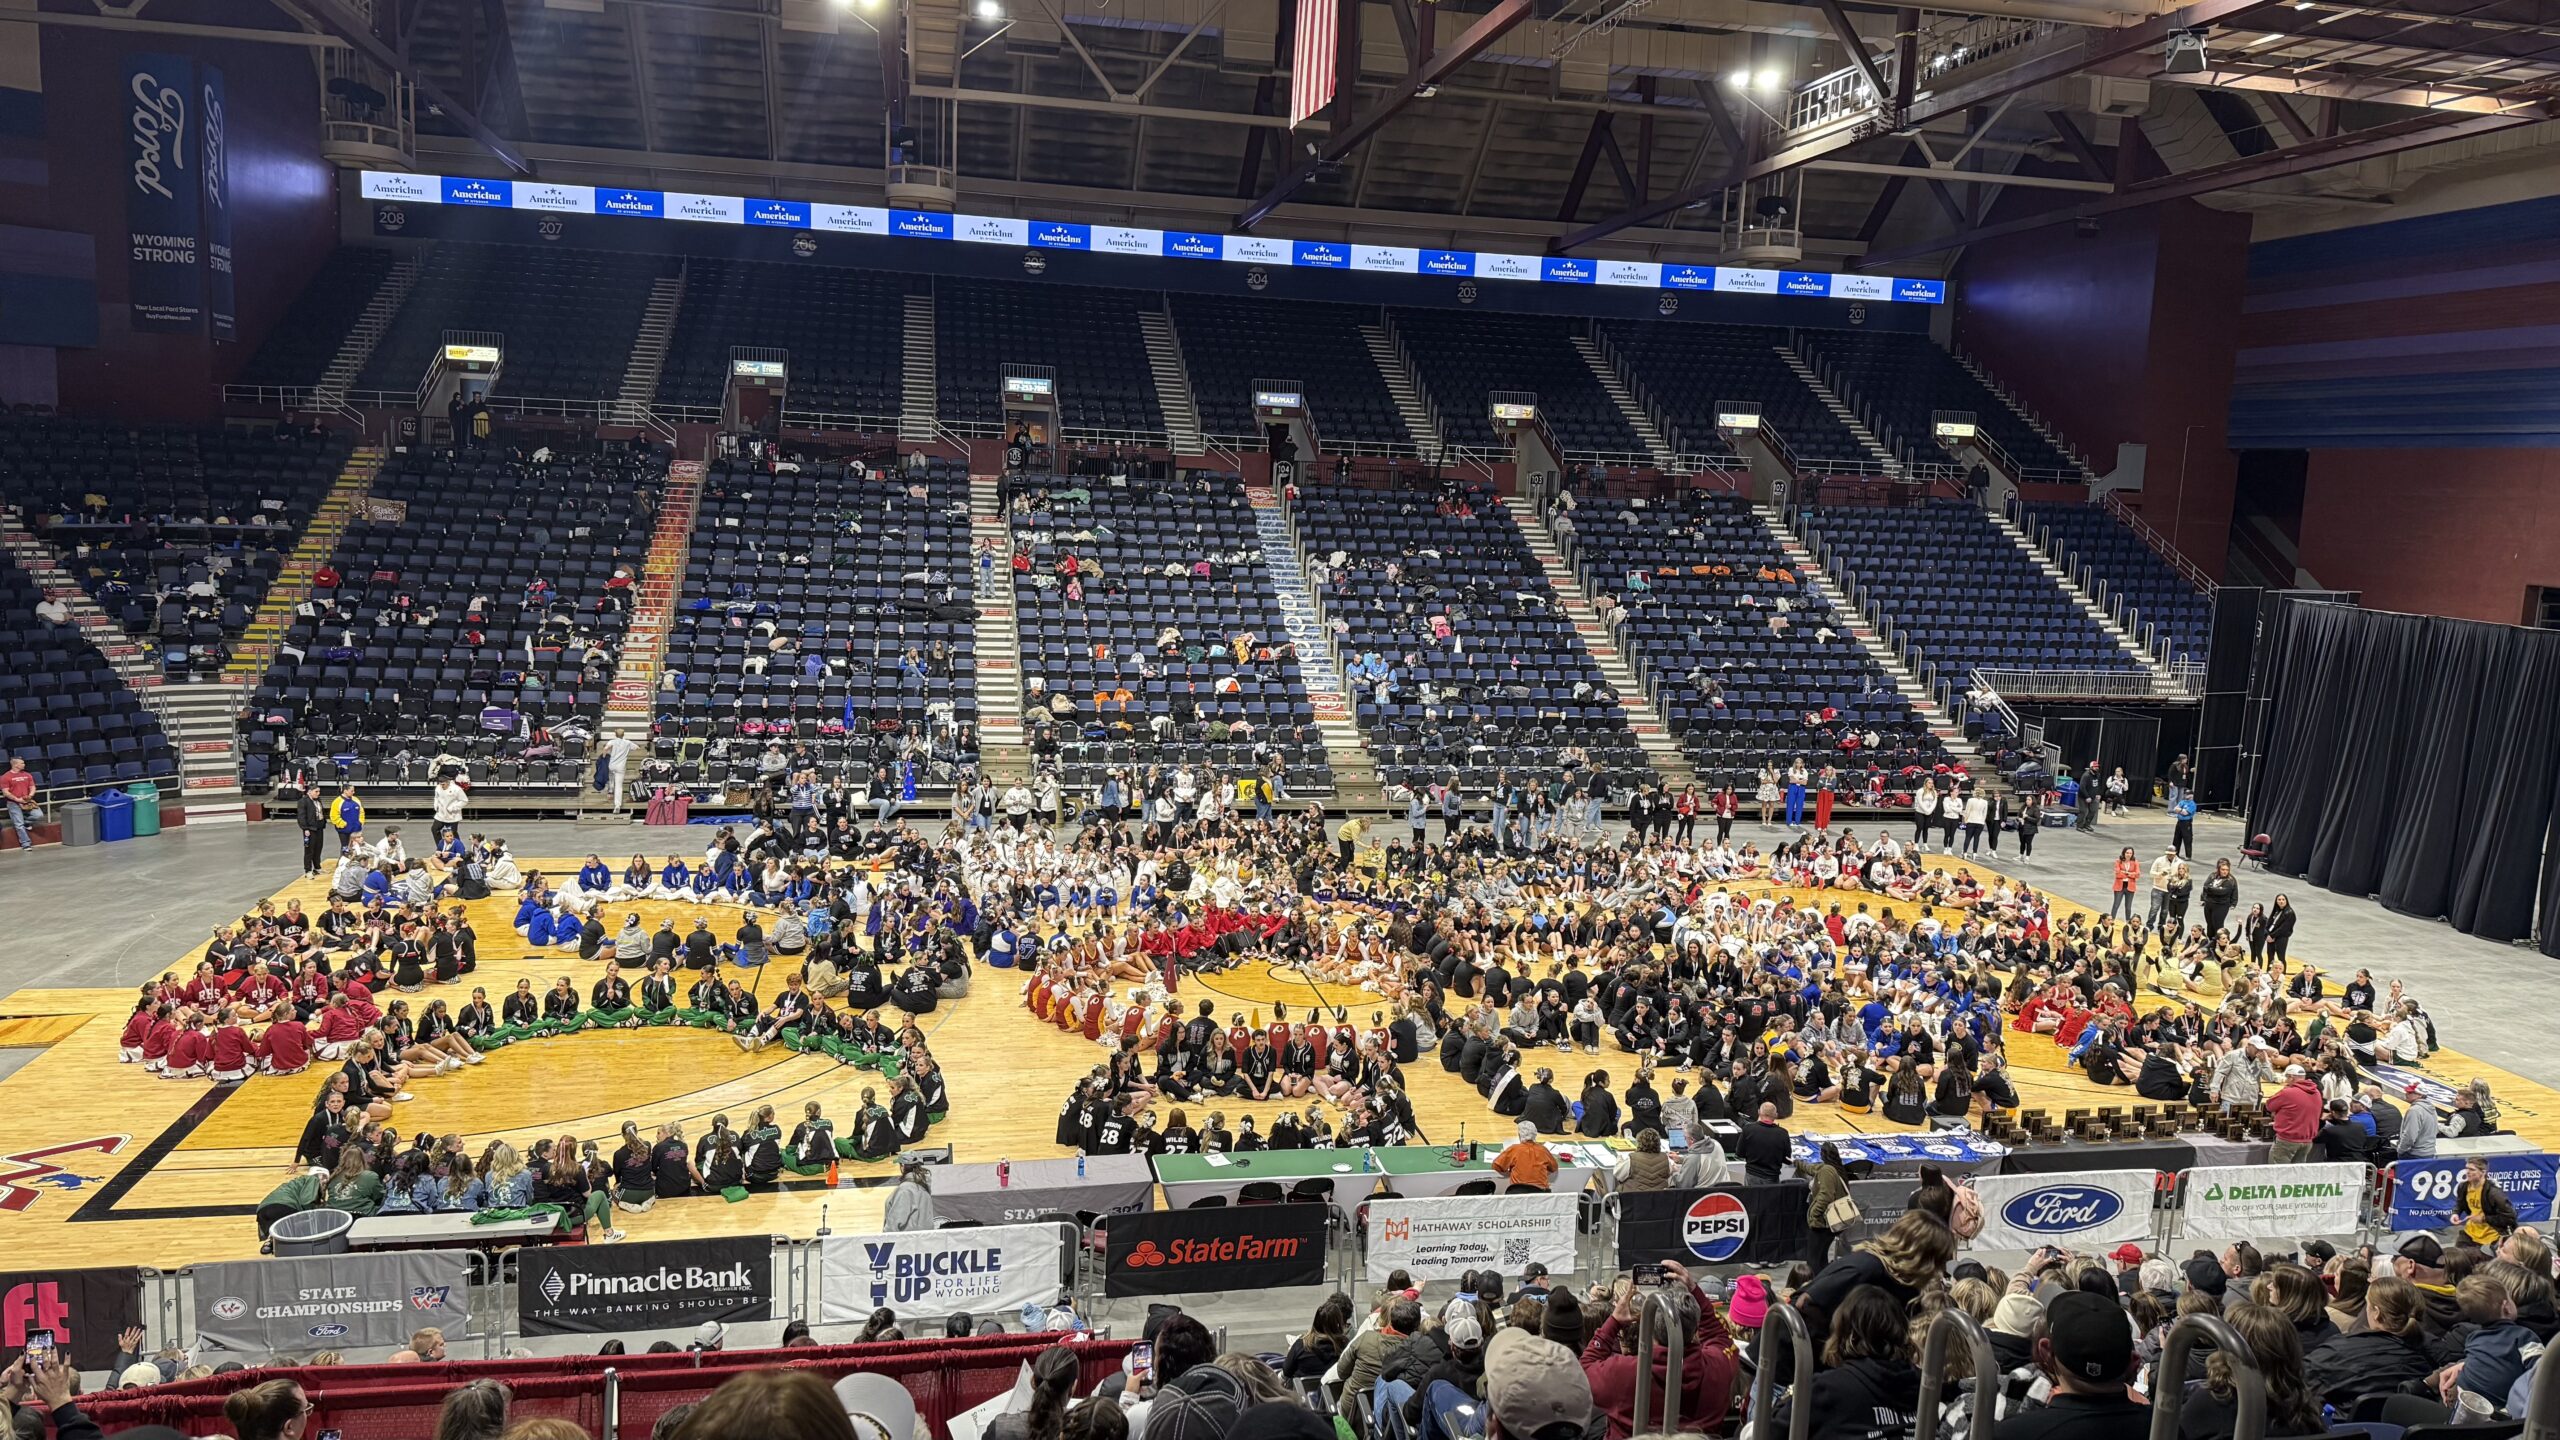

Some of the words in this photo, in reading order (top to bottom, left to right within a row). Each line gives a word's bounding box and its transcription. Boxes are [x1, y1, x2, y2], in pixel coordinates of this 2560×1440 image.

[132, 72, 183, 200] Ford
[204, 84, 225, 209] Ford
[374, 184, 423, 195] AmericInn
[452, 190, 501, 201] AmericInn
[529, 194, 577, 205] AmericInn
[605, 199, 653, 210] AmericInn
[681, 205, 727, 216] AmericInn
[379, 212, 404, 225] 208
[754, 211, 800, 222] AmericInn
[827, 216, 872, 227] AmericInn
[539, 222, 562, 234] 207
[898, 222, 943, 233] AmericInn
[969, 227, 1013, 238] AmericInn
[132, 234, 195, 248] WYOMING
[1038, 232, 1081, 243] AmericInn
[792, 239, 816, 252] 206
[1106, 238, 1148, 249] AmericInn
[1172, 243, 1214, 253] AmericInn
[210, 242, 231, 258] WYOMING
[1238, 248, 1278, 258] AmericInn
[134, 248, 195, 264] STRONG
[1302, 252, 1342, 262] AmericInn
[210, 256, 232, 273] STRONG
[1365, 257, 1405, 267] AmericInn
[1427, 260, 1467, 271] AmericInn
[1489, 265, 1528, 275] AmericInn
[1550, 269, 1589, 278] AmericInn
[1248, 273, 1268, 285] 204
[1610, 272, 1648, 282] AmericInn
[1669, 275, 1707, 285] AmericInn
[1728, 279, 1765, 288] AmericInn
[1786, 282, 1824, 292] AmericInn
[1458, 288, 1477, 298] 203
[1844, 286, 1880, 296] AmericInn
[1901, 289, 1936, 299] AmericInn
[1660, 299, 1678, 310] 202
[1848, 309, 1865, 320] 201
[403, 422, 416, 431] 107
[1010, 452, 1022, 460] 105
[1278, 465, 1290, 473] 104
[1080, 1110, 1093, 1128] 28
[1100, 1128, 1120, 1144] 28
[1165, 1145, 1188, 1154] 27
[2486, 1171, 2513, 1180] SUICIDE
[2514, 1171, 2520, 1179] &
[2520, 1170, 2541, 1178] CRISIS
[2497, 1180, 2540, 1191] FELINE
[2229, 1184, 2276, 1200] DELTA
[2280, 1183, 2342, 1198] DENTAL
[2026, 1193, 2100, 1225] Ford
[2419, 1209, 2452, 1217] judgmen
[1413, 1222, 1472, 1232] HATHAWAY
[1477, 1219, 1551, 1230] SCHOLARSHIP
[1864, 1216, 1901, 1225] CHAMPIO
[1688, 1218, 1744, 1235] PEPSI
[1416, 1245, 1456, 1254] Learning
[1459, 1243, 1488, 1252] Today,
[896, 1248, 1001, 1278] BUCKLE
[1411, 1257, 1448, 1267] Leading
[1450, 1255, 1494, 1264] Tomorrow
[570, 1266, 682, 1296] Pinnacle
[686, 1262, 751, 1288] Bank
[936, 1278, 962, 1288] FOR
[970, 1276, 1001, 1286] LIFE,
[299, 1287, 356, 1300] STATE
[414, 1286, 450, 1302] 307
[894, 1278, 931, 1303] UP
[936, 1286, 1000, 1298] WYOMING
[255, 1300, 403, 1319] CHAMPIONSHIPS
[534, 1309, 560, 1317] THE
[607, 1303, 670, 1313] BANKING
[679, 1298, 733, 1309] SHOULD
[315, 1325, 340, 1336] Ford
